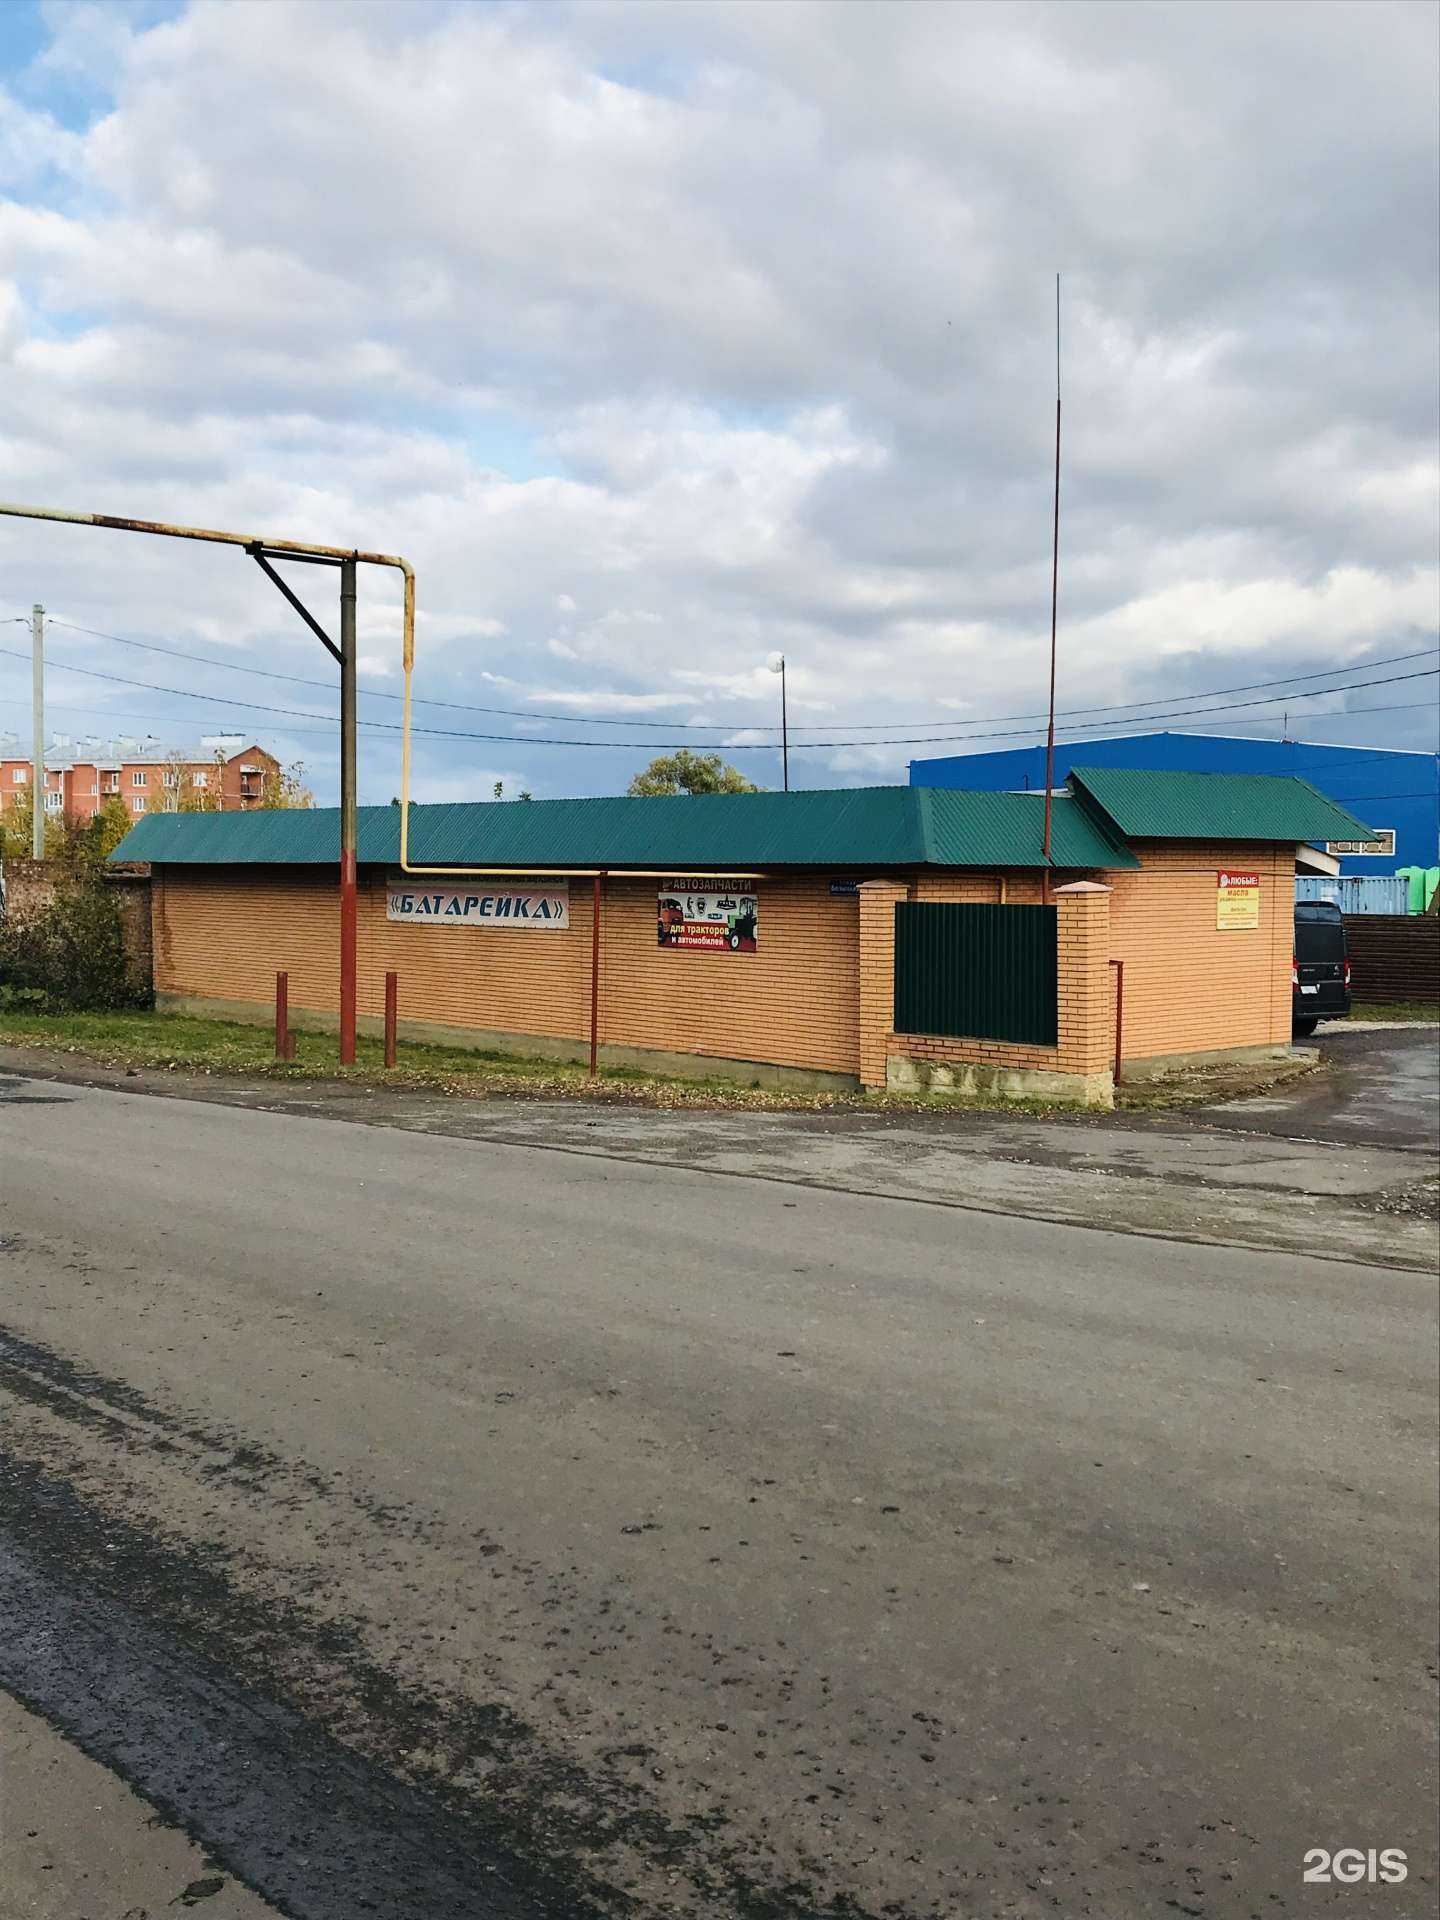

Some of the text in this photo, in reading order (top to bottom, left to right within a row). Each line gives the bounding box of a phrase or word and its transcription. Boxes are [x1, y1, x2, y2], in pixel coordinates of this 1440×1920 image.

[673, 879, 752, 890] АВТОЗАПЧАСТИ
[670, 924, 729, 936] для тракторов
[678, 936, 724, 945] автомобилей
